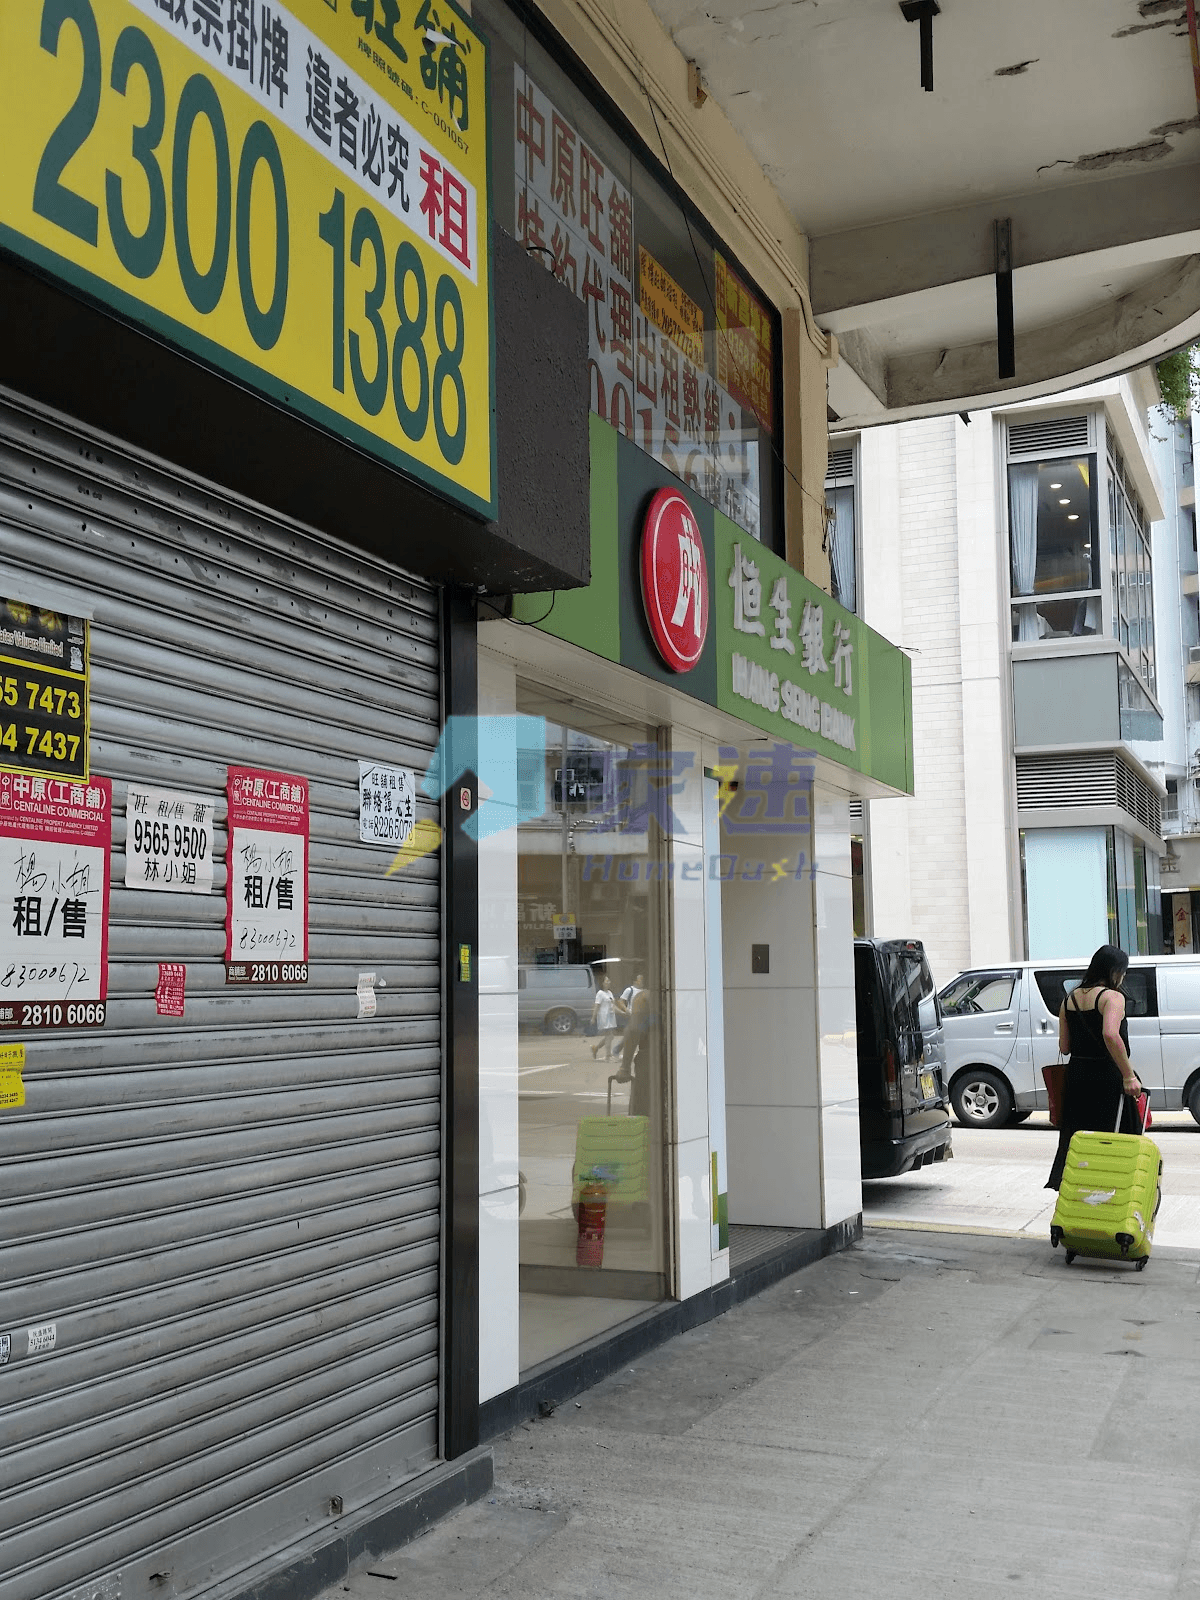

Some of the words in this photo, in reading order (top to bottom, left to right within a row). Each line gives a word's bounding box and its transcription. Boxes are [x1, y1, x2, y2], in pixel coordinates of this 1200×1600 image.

[155, 0, 289, 109] 掛牌
[305, 44, 410, 213] 違者必究
[420, 99, 470, 154] C-001057
[419, 148, 471, 270] 租
[32, 0, 290, 351] 2300
[318, 186, 468, 466] 1388
[728, 542, 854, 696] 恒生銀行
[14, 630, 39, 652] Valuers
[39, 637, 64, 658] Limited
[26, 681, 81, 719] 7473
[732, 652, 780, 713] HANG
[780, 679, 821, 734] SENG
[820, 701, 857, 752] BANK
[0, 723, 18, 752] 4
[26, 726, 81, 762] 7437
[241, 776, 305, 804] 中原(工商舖)
[242, 797, 271, 810] CENTALINE
[271, 801, 305, 815] COMMERCIAL
[13, 800, 57, 816] CENTALINE
[57, 805, 106, 823] COMMERCIAL
[134, 819, 169, 856] 9565
[174, 824, 207, 860] 9500
[144, 857, 197, 885] 林小姐
[244, 875, 294, 910] 租/售
[12, 895, 87, 938] 租/售
[251, 964, 279, 981] 2810
[281, 964, 308, 981] 6066
[21, 1005, 63, 1026] 2810
[67, 1003, 105, 1025] 6066
